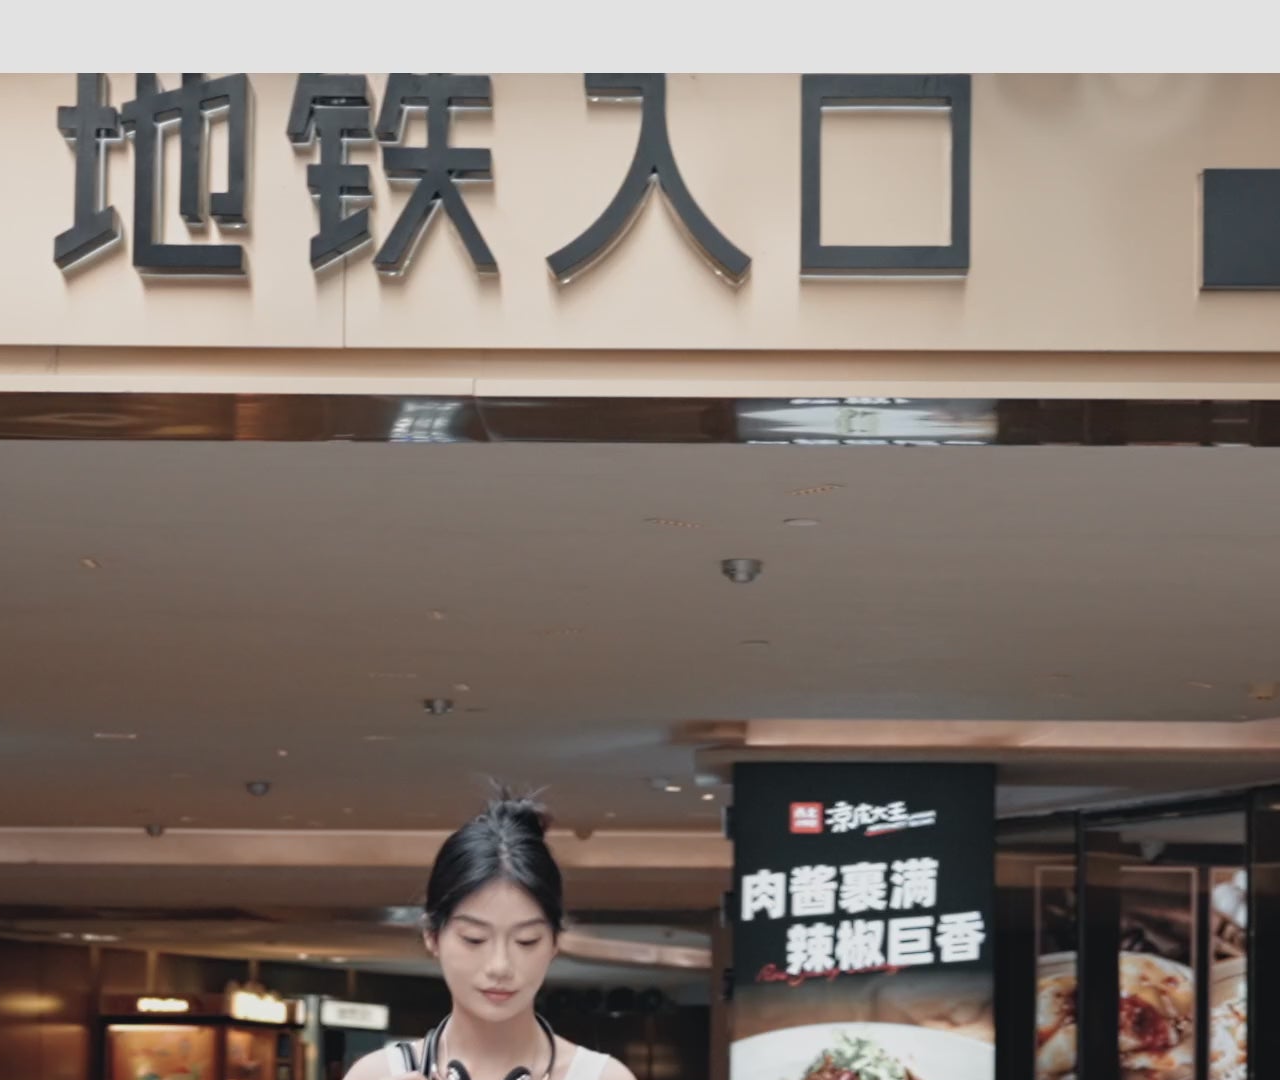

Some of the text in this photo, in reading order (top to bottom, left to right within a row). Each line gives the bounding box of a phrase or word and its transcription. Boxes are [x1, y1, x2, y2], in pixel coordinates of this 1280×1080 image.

[54, 73, 971, 284] 地铁入口
[741, 857, 939, 921] 肉酱裹满
[786, 911, 985, 976] 辣椒巨香
